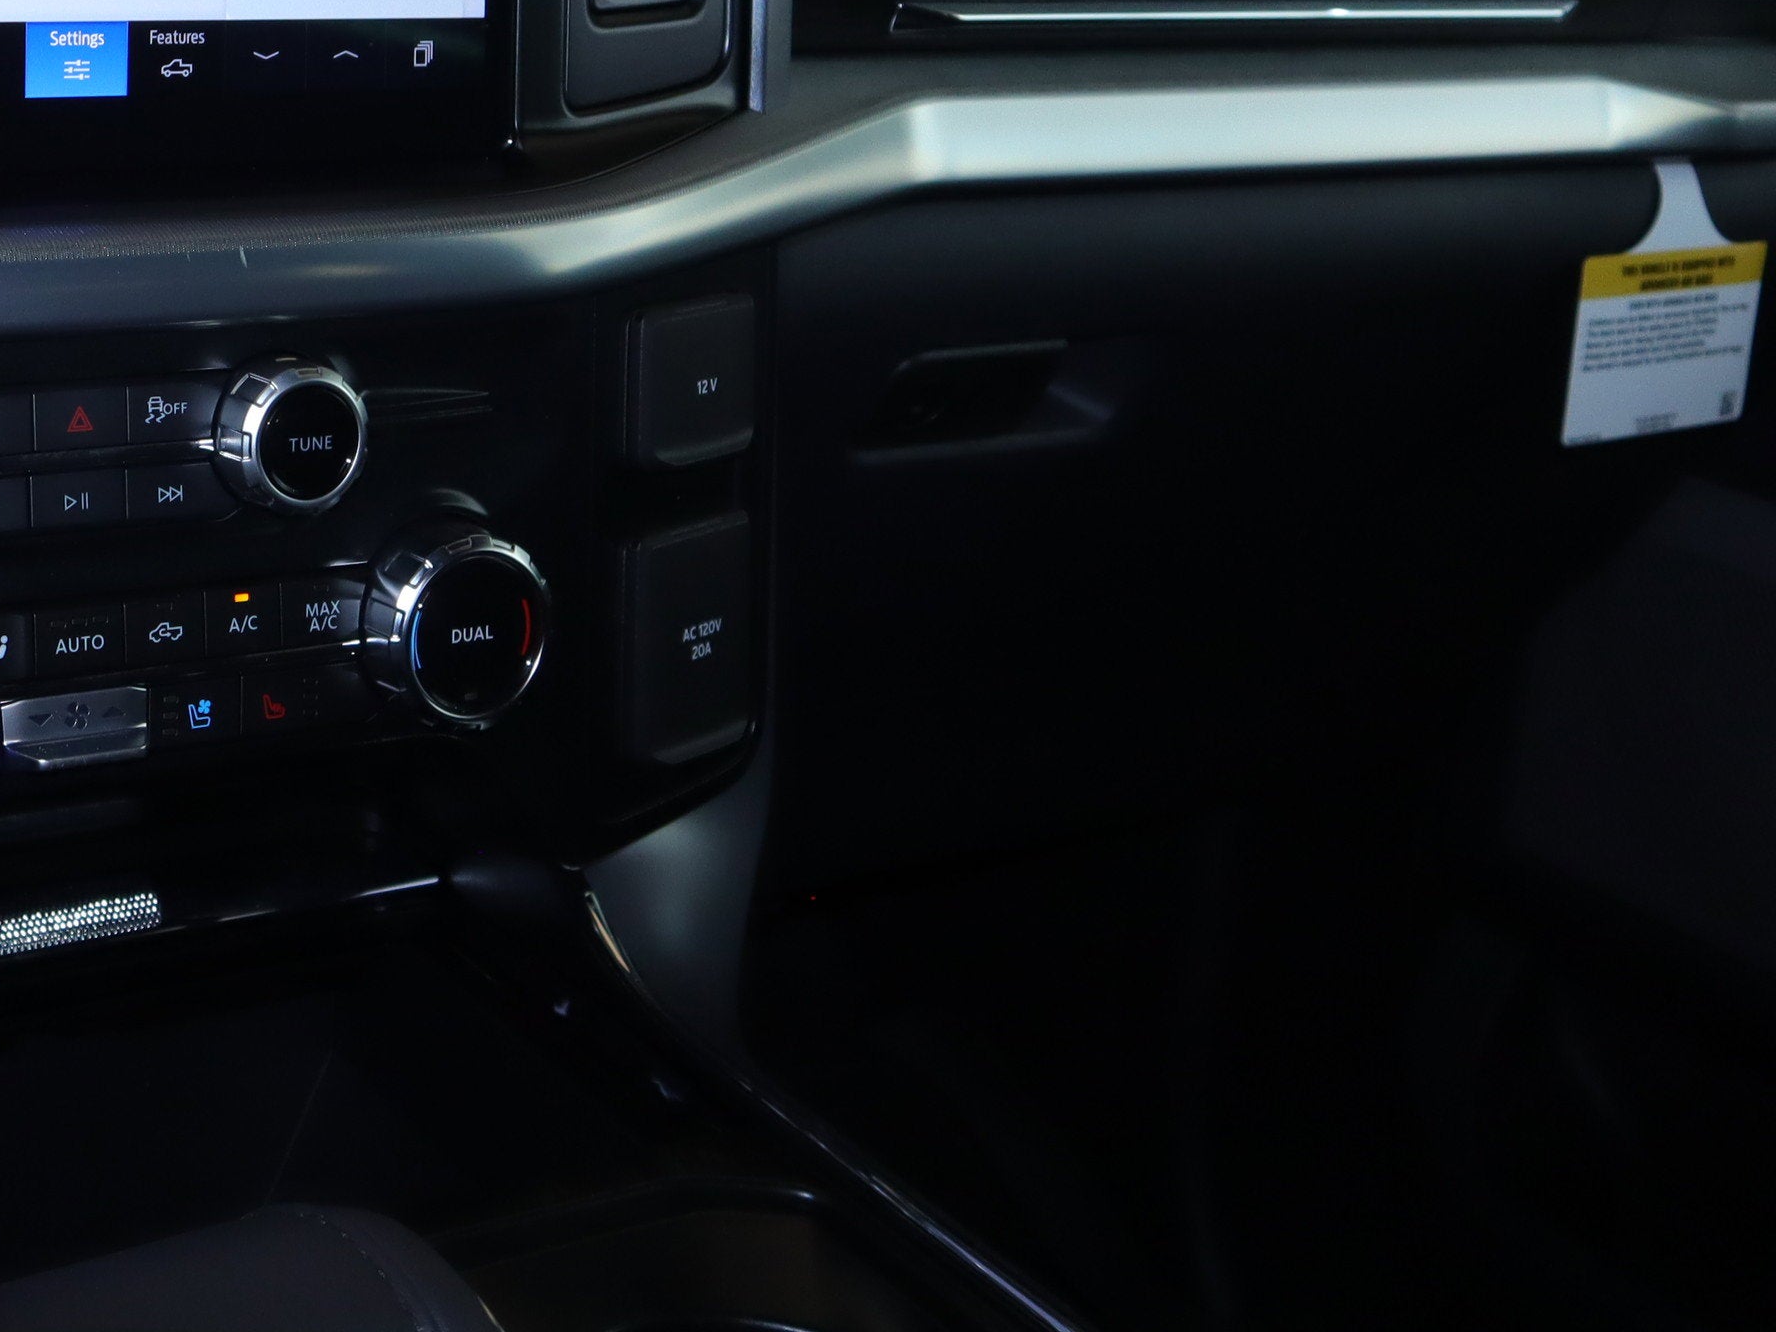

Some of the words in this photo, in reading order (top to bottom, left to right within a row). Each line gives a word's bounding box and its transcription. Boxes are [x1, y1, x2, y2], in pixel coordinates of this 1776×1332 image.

[49, 29, 105, 50] Settings
[149, 29, 205, 46] Features
[697, 380, 709, 395] 12
[162, 401, 188, 416] OFF
[288, 435, 333, 452] TUNE
[304, 600, 341, 619] MAX
[228, 614, 259, 634] A/C
[309, 613, 339, 632] A/C
[683, 627, 697, 642] AC
[698, 618, 723, 638] 120V
[55, 634, 106, 654] AUTO
[451, 625, 495, 644] DUAL
[691, 642, 712, 660] 20A
